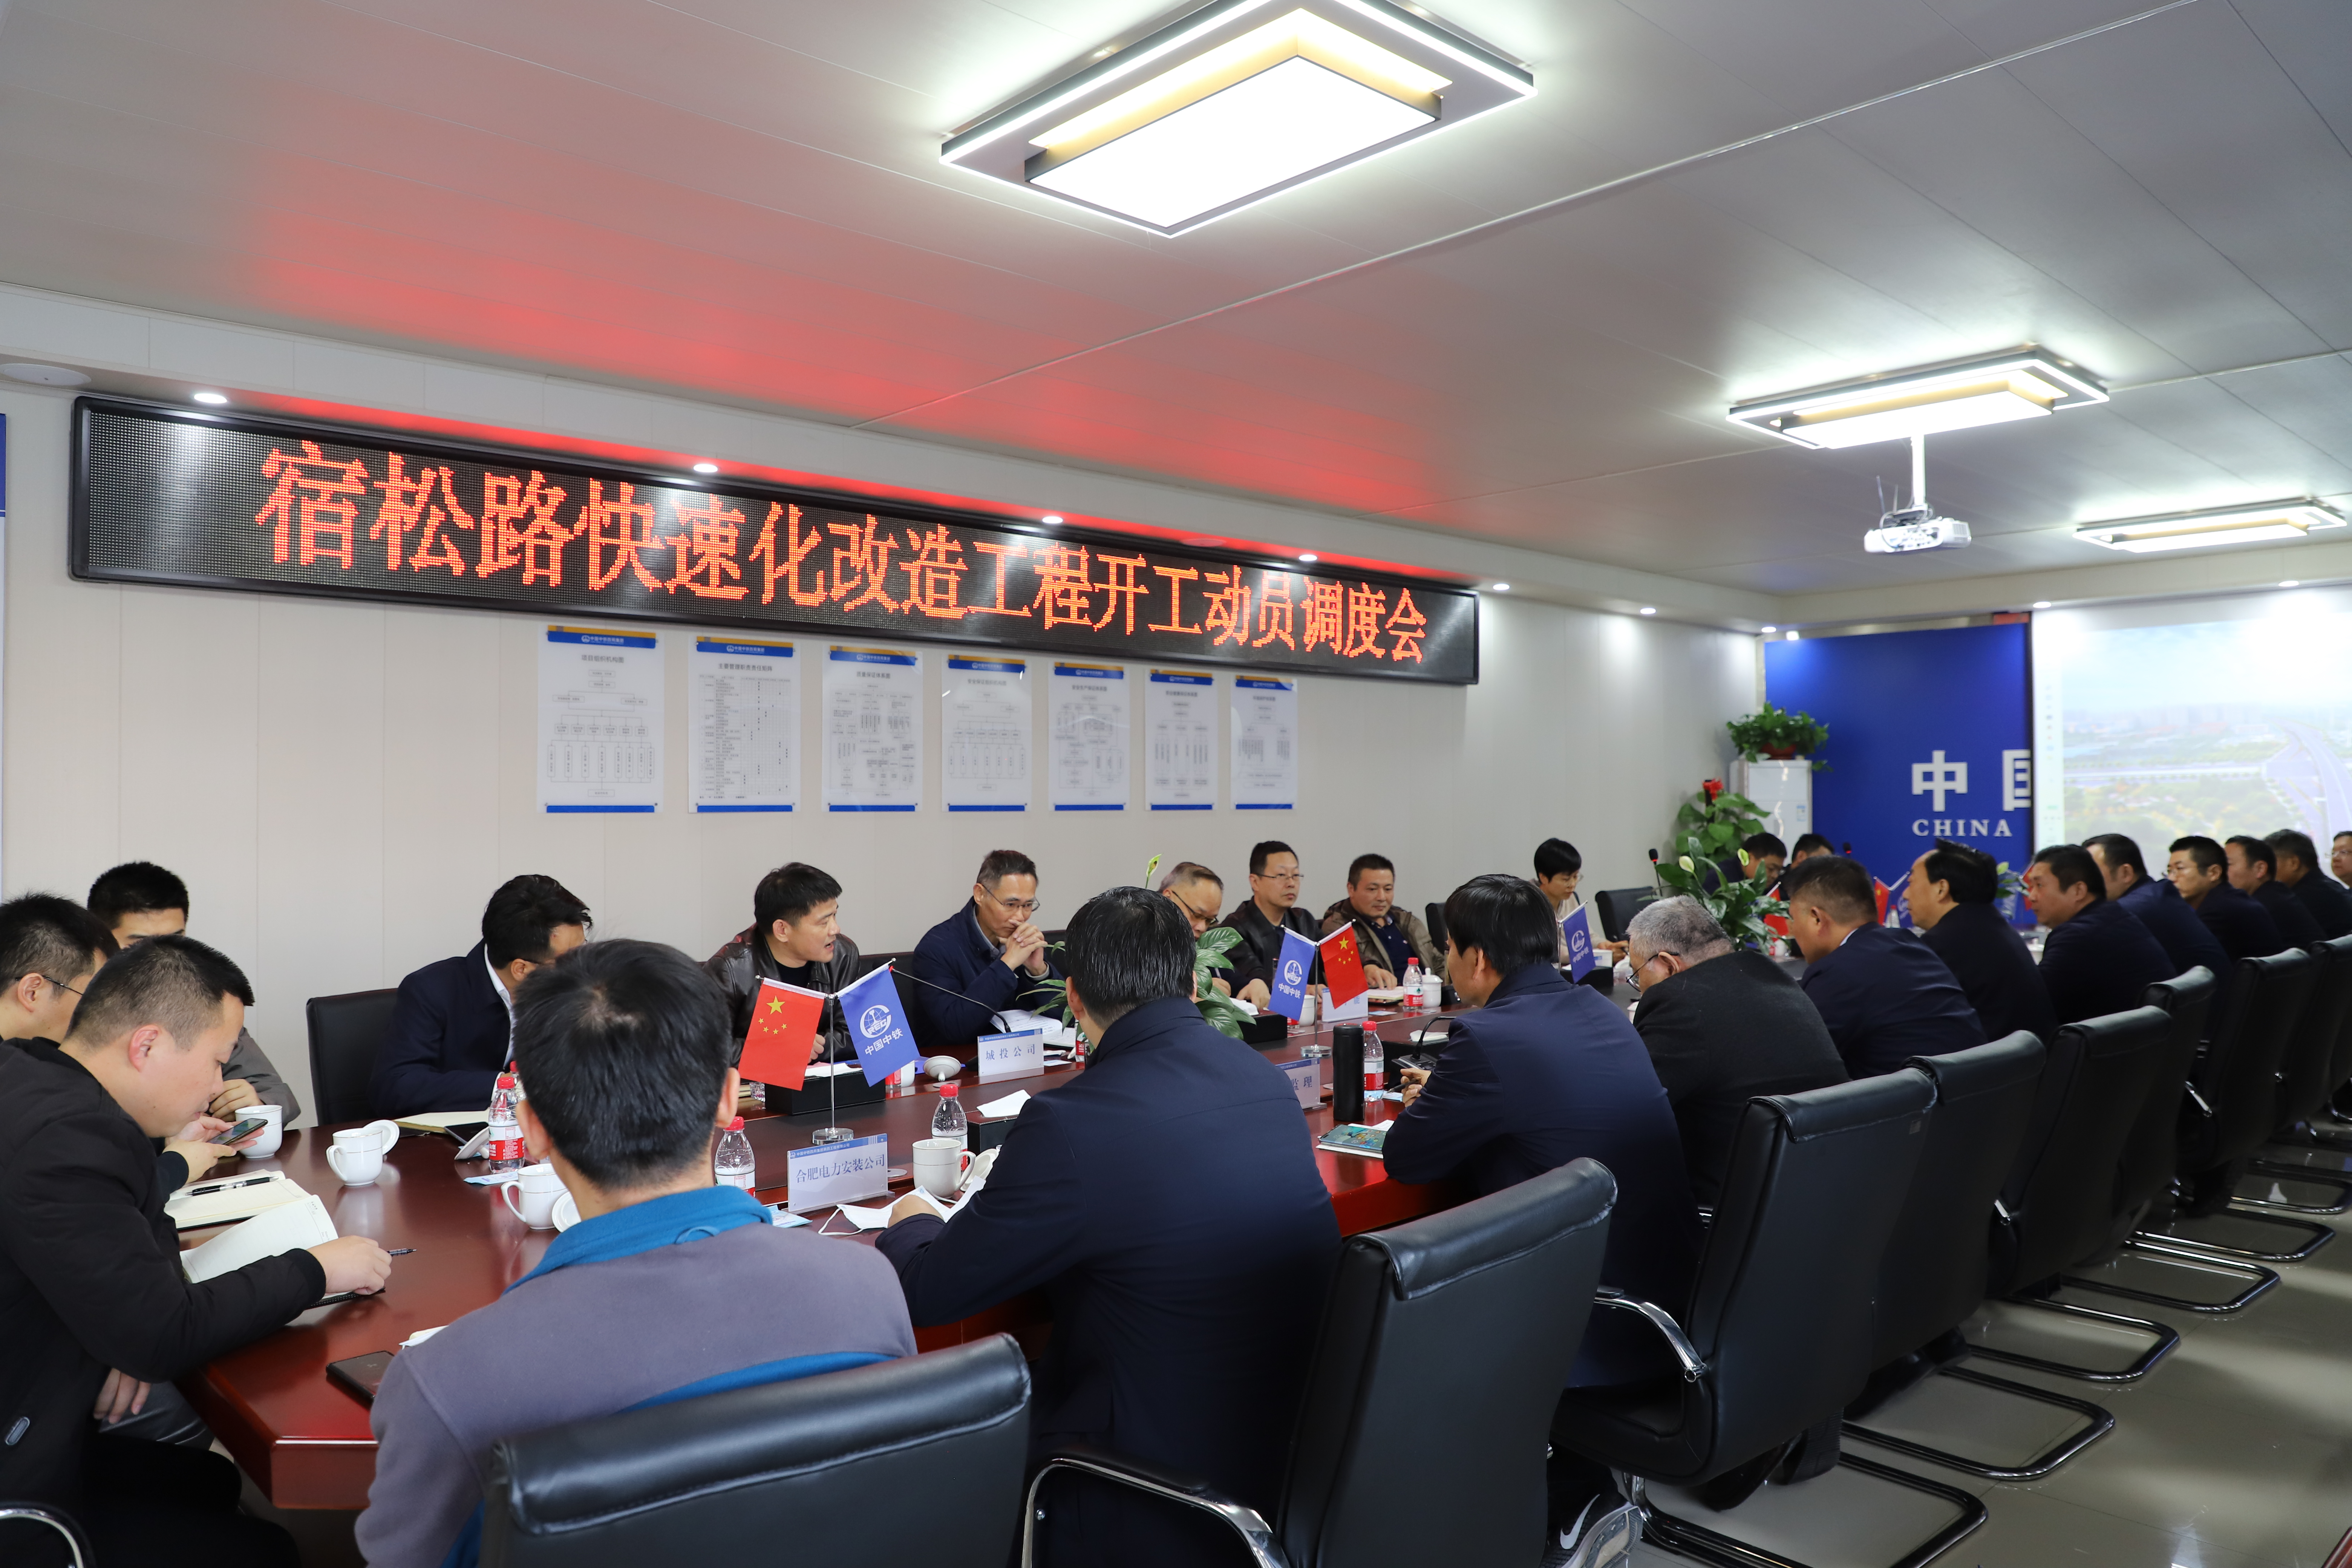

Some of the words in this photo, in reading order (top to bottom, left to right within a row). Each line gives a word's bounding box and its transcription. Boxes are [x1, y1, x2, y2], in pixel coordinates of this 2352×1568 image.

[255, 439, 1427, 663] 宿松路快速化改造工程开工动员调度会
[582, 655, 624, 663] 项目组织机构图
[1912, 819, 2013, 837] CHINA
[1278, 983, 1301, 999] 中国中铁
[865, 1028, 903, 1055] 中国中铁
[985, 1044, 1035, 1061] 城投公司
[1291, 1076, 1312, 1090] 监理
[796, 1143, 850, 1156] 中国中铁四局集团第四工程有限公司
[795, 1154, 885, 1184] 合肥电力安装公司
